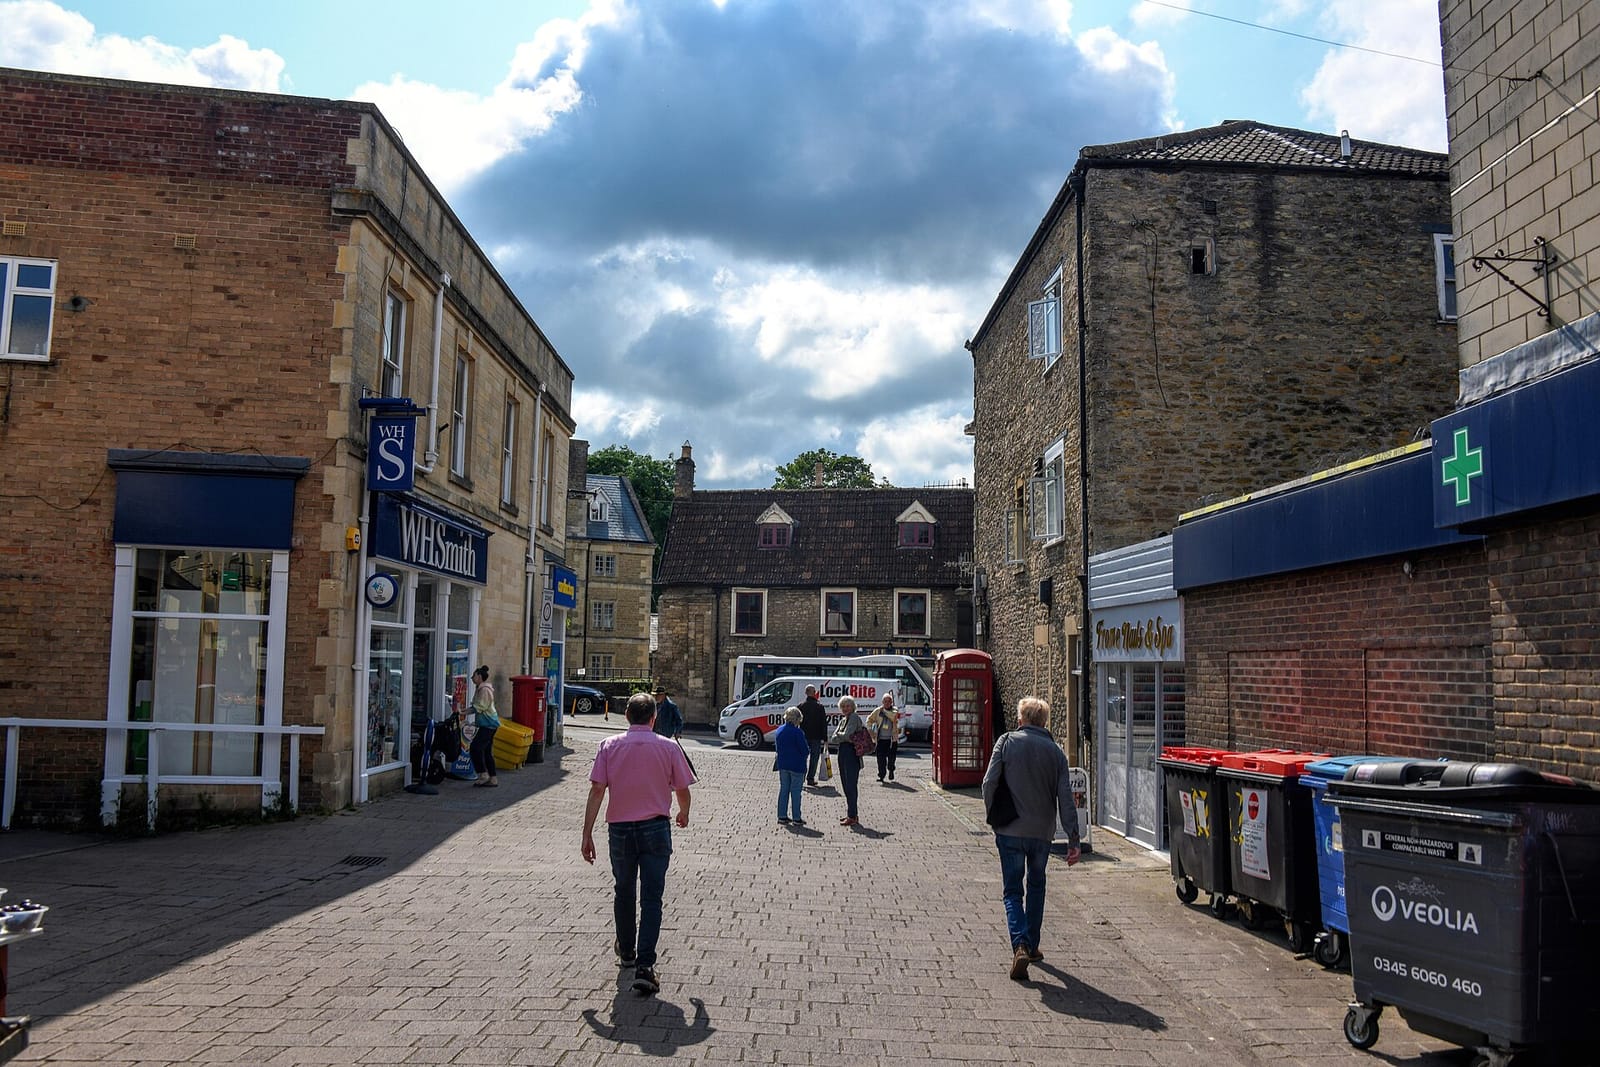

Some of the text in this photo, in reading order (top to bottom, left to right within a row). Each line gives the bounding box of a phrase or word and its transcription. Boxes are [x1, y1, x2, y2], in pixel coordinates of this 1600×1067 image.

[378, 425, 406, 438] WH
[376, 437, 406, 482] S
[400, 504, 477, 578] WHSmith
[1096, 619, 1121, 649] Frome
[1144, 618, 1153, 651] &
[1154, 615, 1175, 656] Spa
[895, 648, 923, 656] BLUE
[820, 682, 876, 698] LockRite
[1384, 833, 1454, 850] GENERAL NON-HAZARDOUS
[1391, 842, 1446, 858] COMPACTABLE WASTE
[1399, 898, 1479, 935] VEOLIA
[1373, 956, 1482, 997] 0345 6060 460
